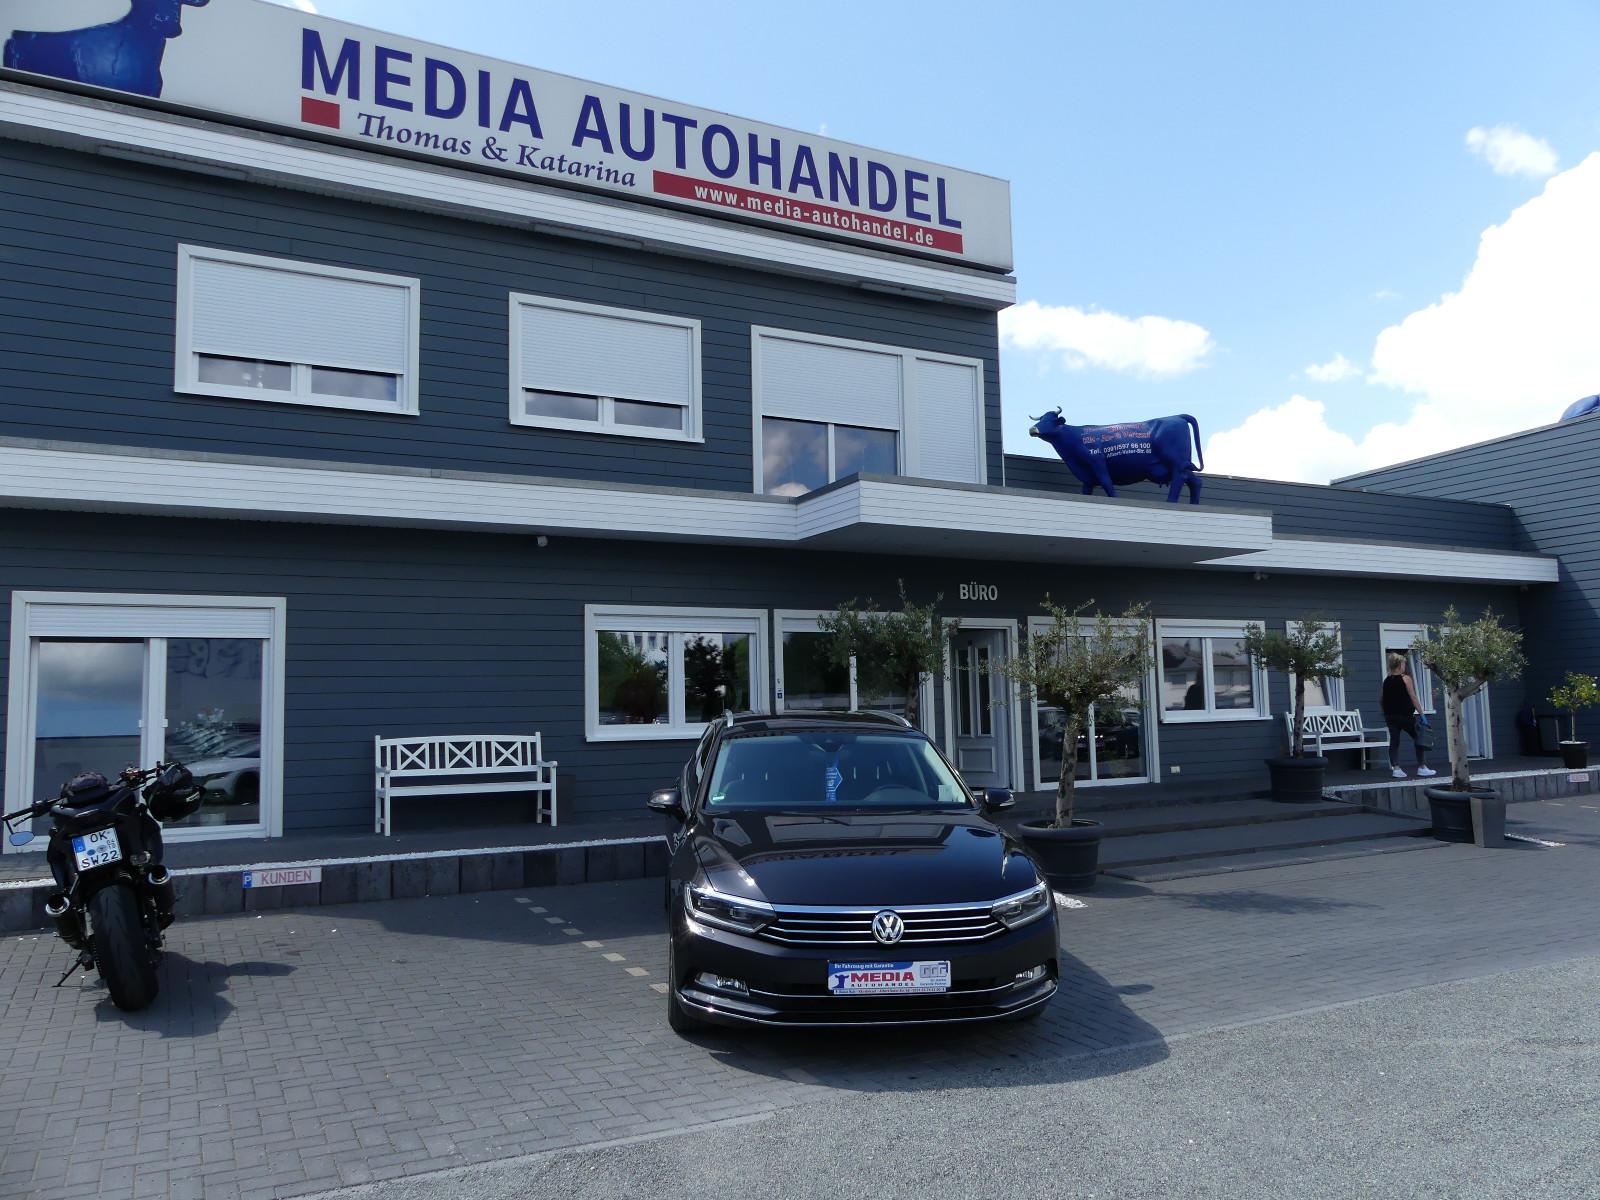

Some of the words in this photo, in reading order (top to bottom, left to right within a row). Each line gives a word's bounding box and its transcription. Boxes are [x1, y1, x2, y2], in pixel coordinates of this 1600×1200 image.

[301, 28, 544, 140] MEDIA
[571, 94, 962, 229] AUTOHANDEL
[357, 112, 471, 156] Thomas
[481, 136, 508, 162] &
[516, 144, 636, 187] Katarina
[694, 184, 934, 247] www.media-autohandel.de
[960, 581, 998, 600] BÜRO
[90, 831, 107, 843] OK
[261, 869, 312, 885] KUNDEN
[851, 972, 915, 983] MEDIA
